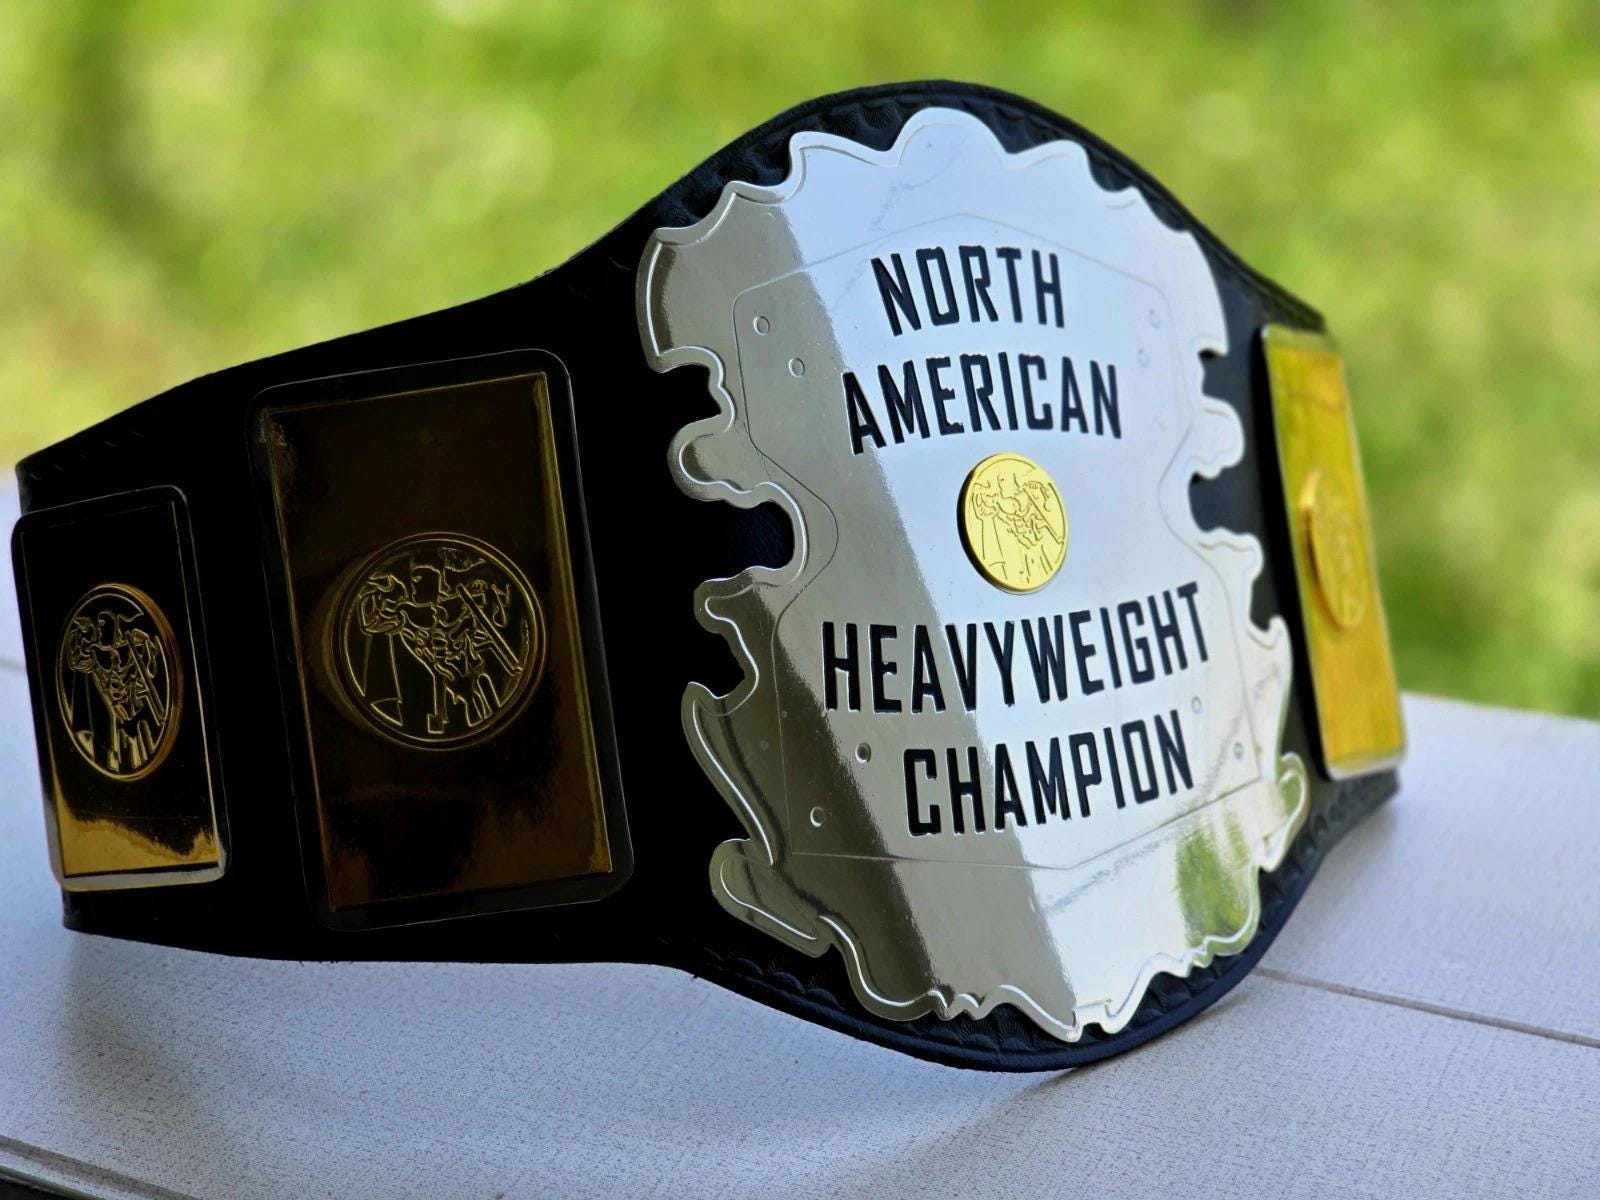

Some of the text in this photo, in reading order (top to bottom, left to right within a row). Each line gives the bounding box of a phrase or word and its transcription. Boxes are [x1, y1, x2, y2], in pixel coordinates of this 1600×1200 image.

[871, 246, 1064, 336] NORTH
[842, 352, 1122, 455] AMERICAN
[822, 582, 1209, 713] HEAVYWEIGHT
[904, 709, 1194, 836] CHAMPION
